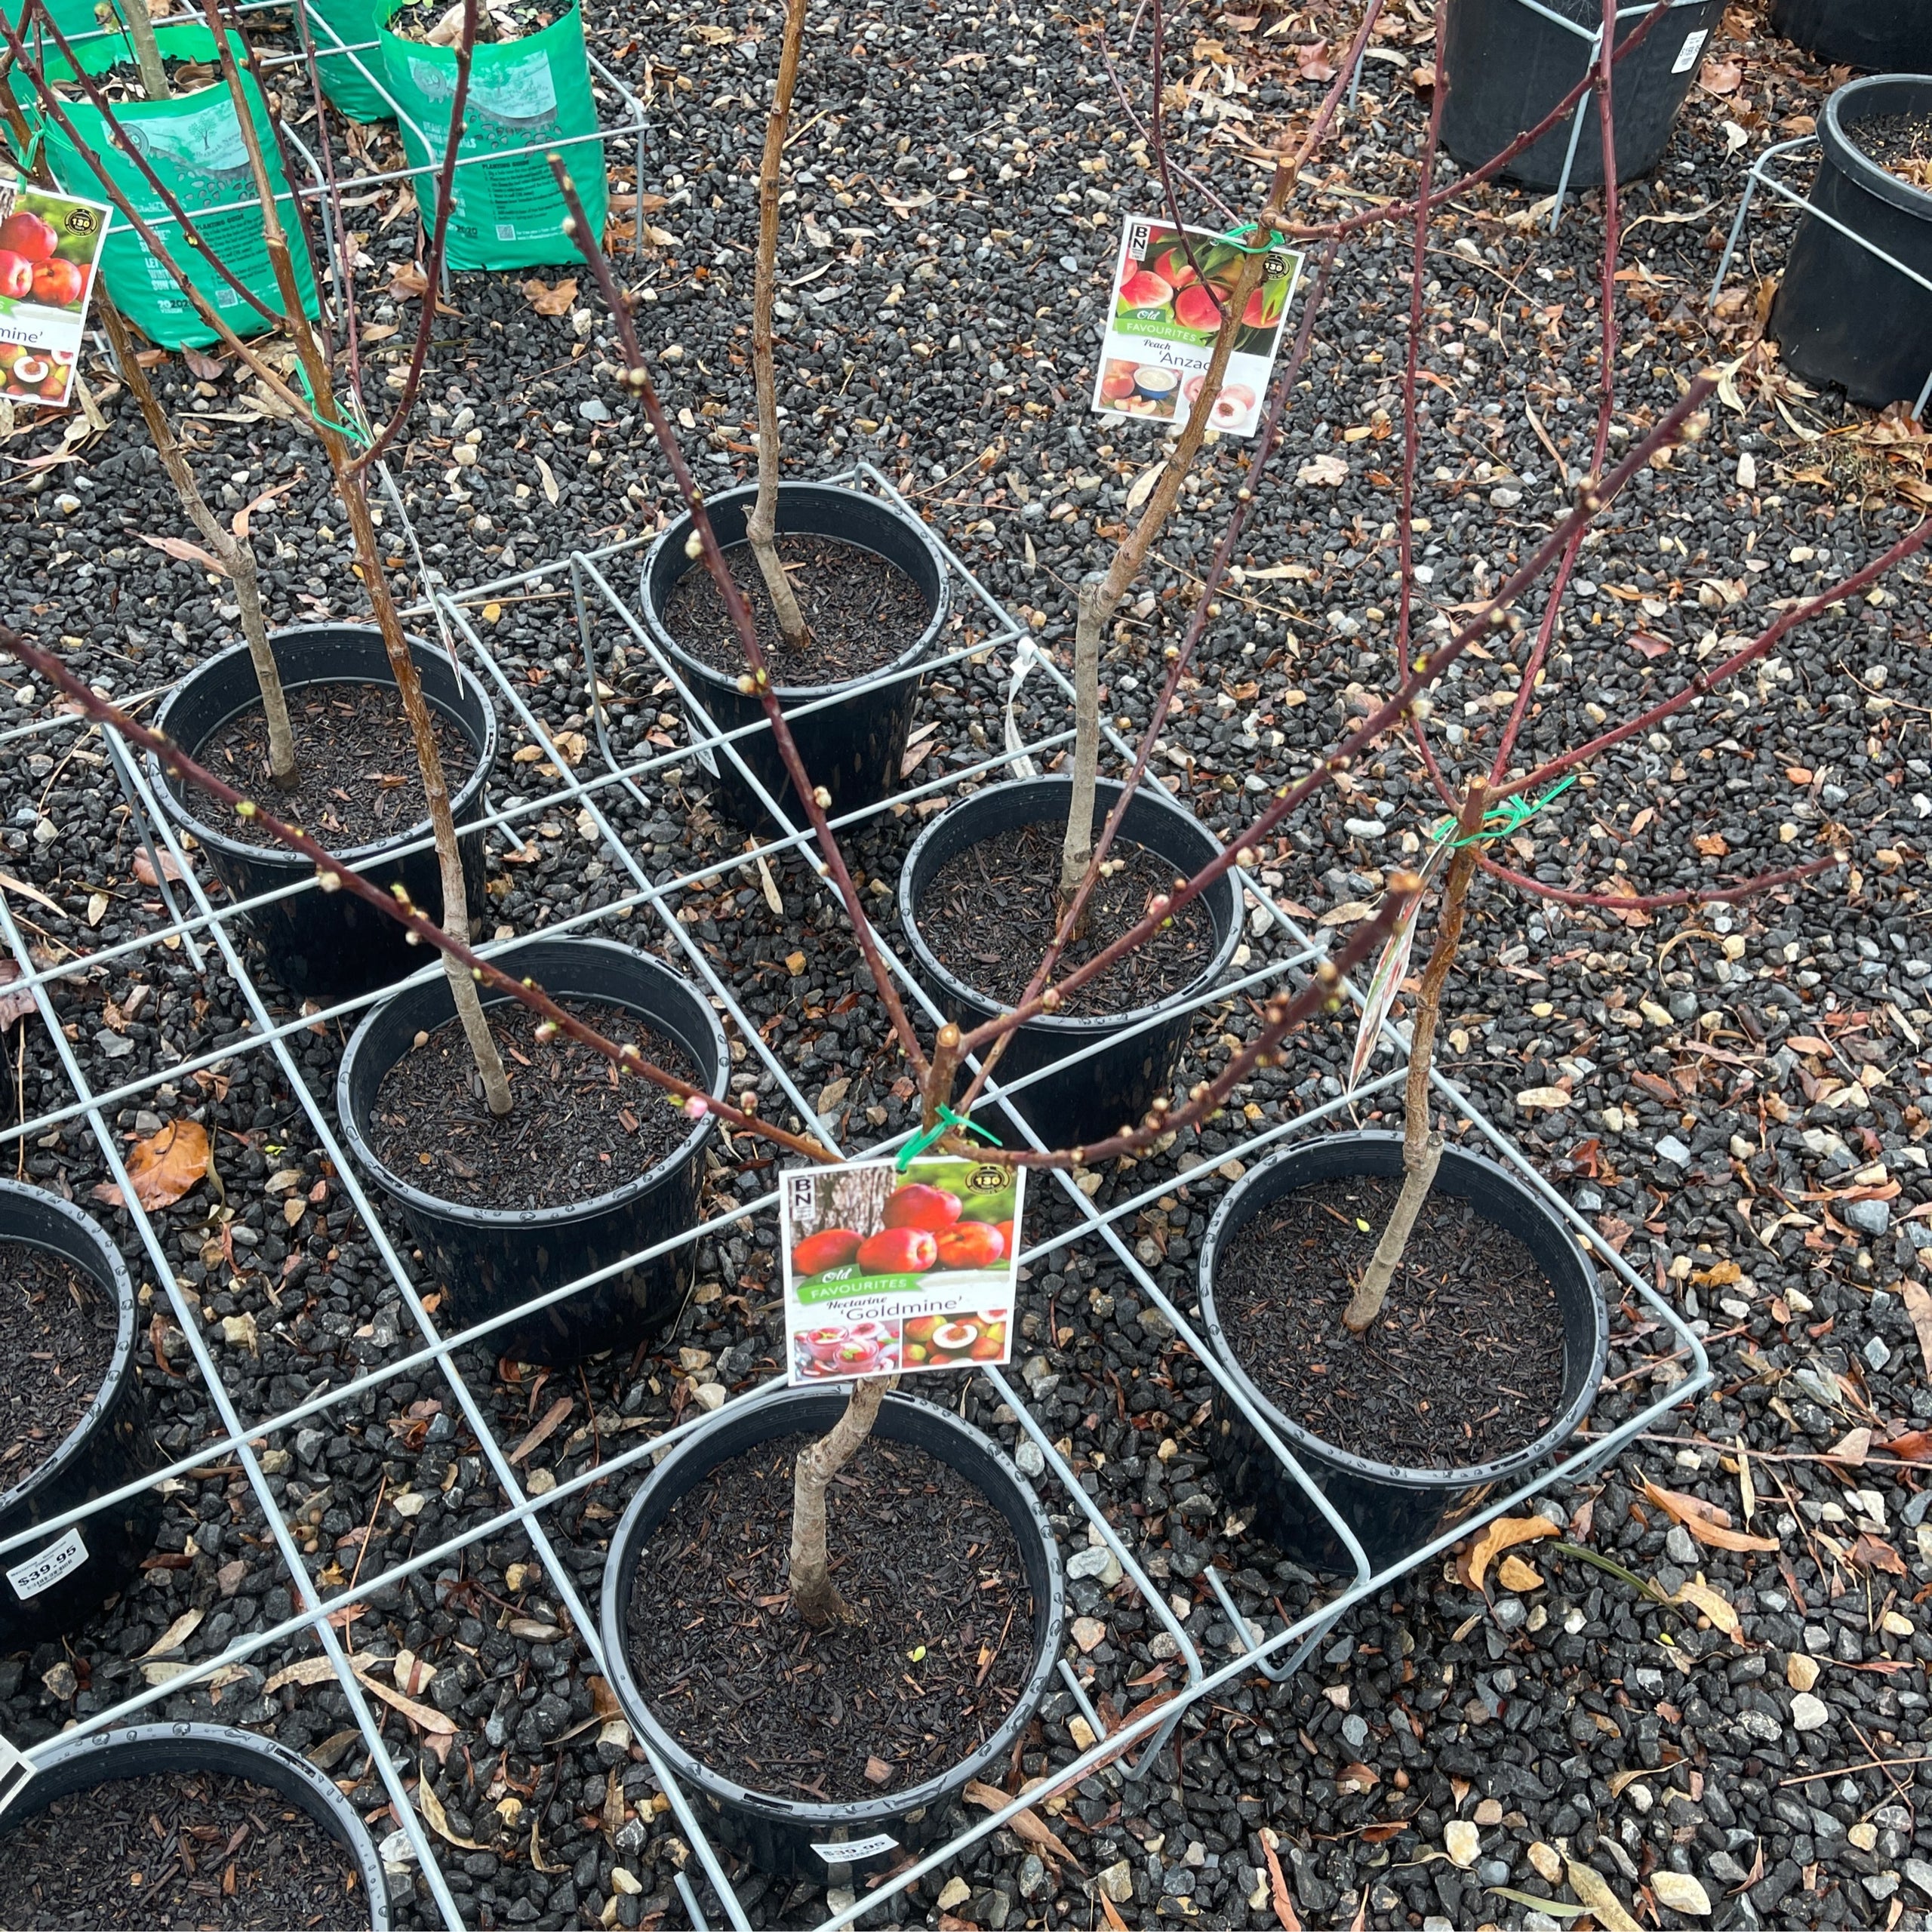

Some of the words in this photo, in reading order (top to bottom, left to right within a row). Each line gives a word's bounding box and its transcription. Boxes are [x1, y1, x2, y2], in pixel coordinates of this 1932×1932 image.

[72, 218, 90, 228] 130
[1264, 262, 1283, 272] 130
[1137, 309, 1161, 321] Old
[1126, 322, 1198, 343] FAVOURITES
[1143, 338, 1171, 351] Peach
[975, 1177, 1001, 1186] 130
[821, 1267, 853, 1284] Old
[811, 1278, 908, 1300] FAVOURITES
[826, 1295, 888, 1310] Nectarine
[840, 1295, 964, 1321] 'Goldmine'
[17, 1544, 77, 1587] $39.95
[823, 1841, 885, 1857] $39.95
